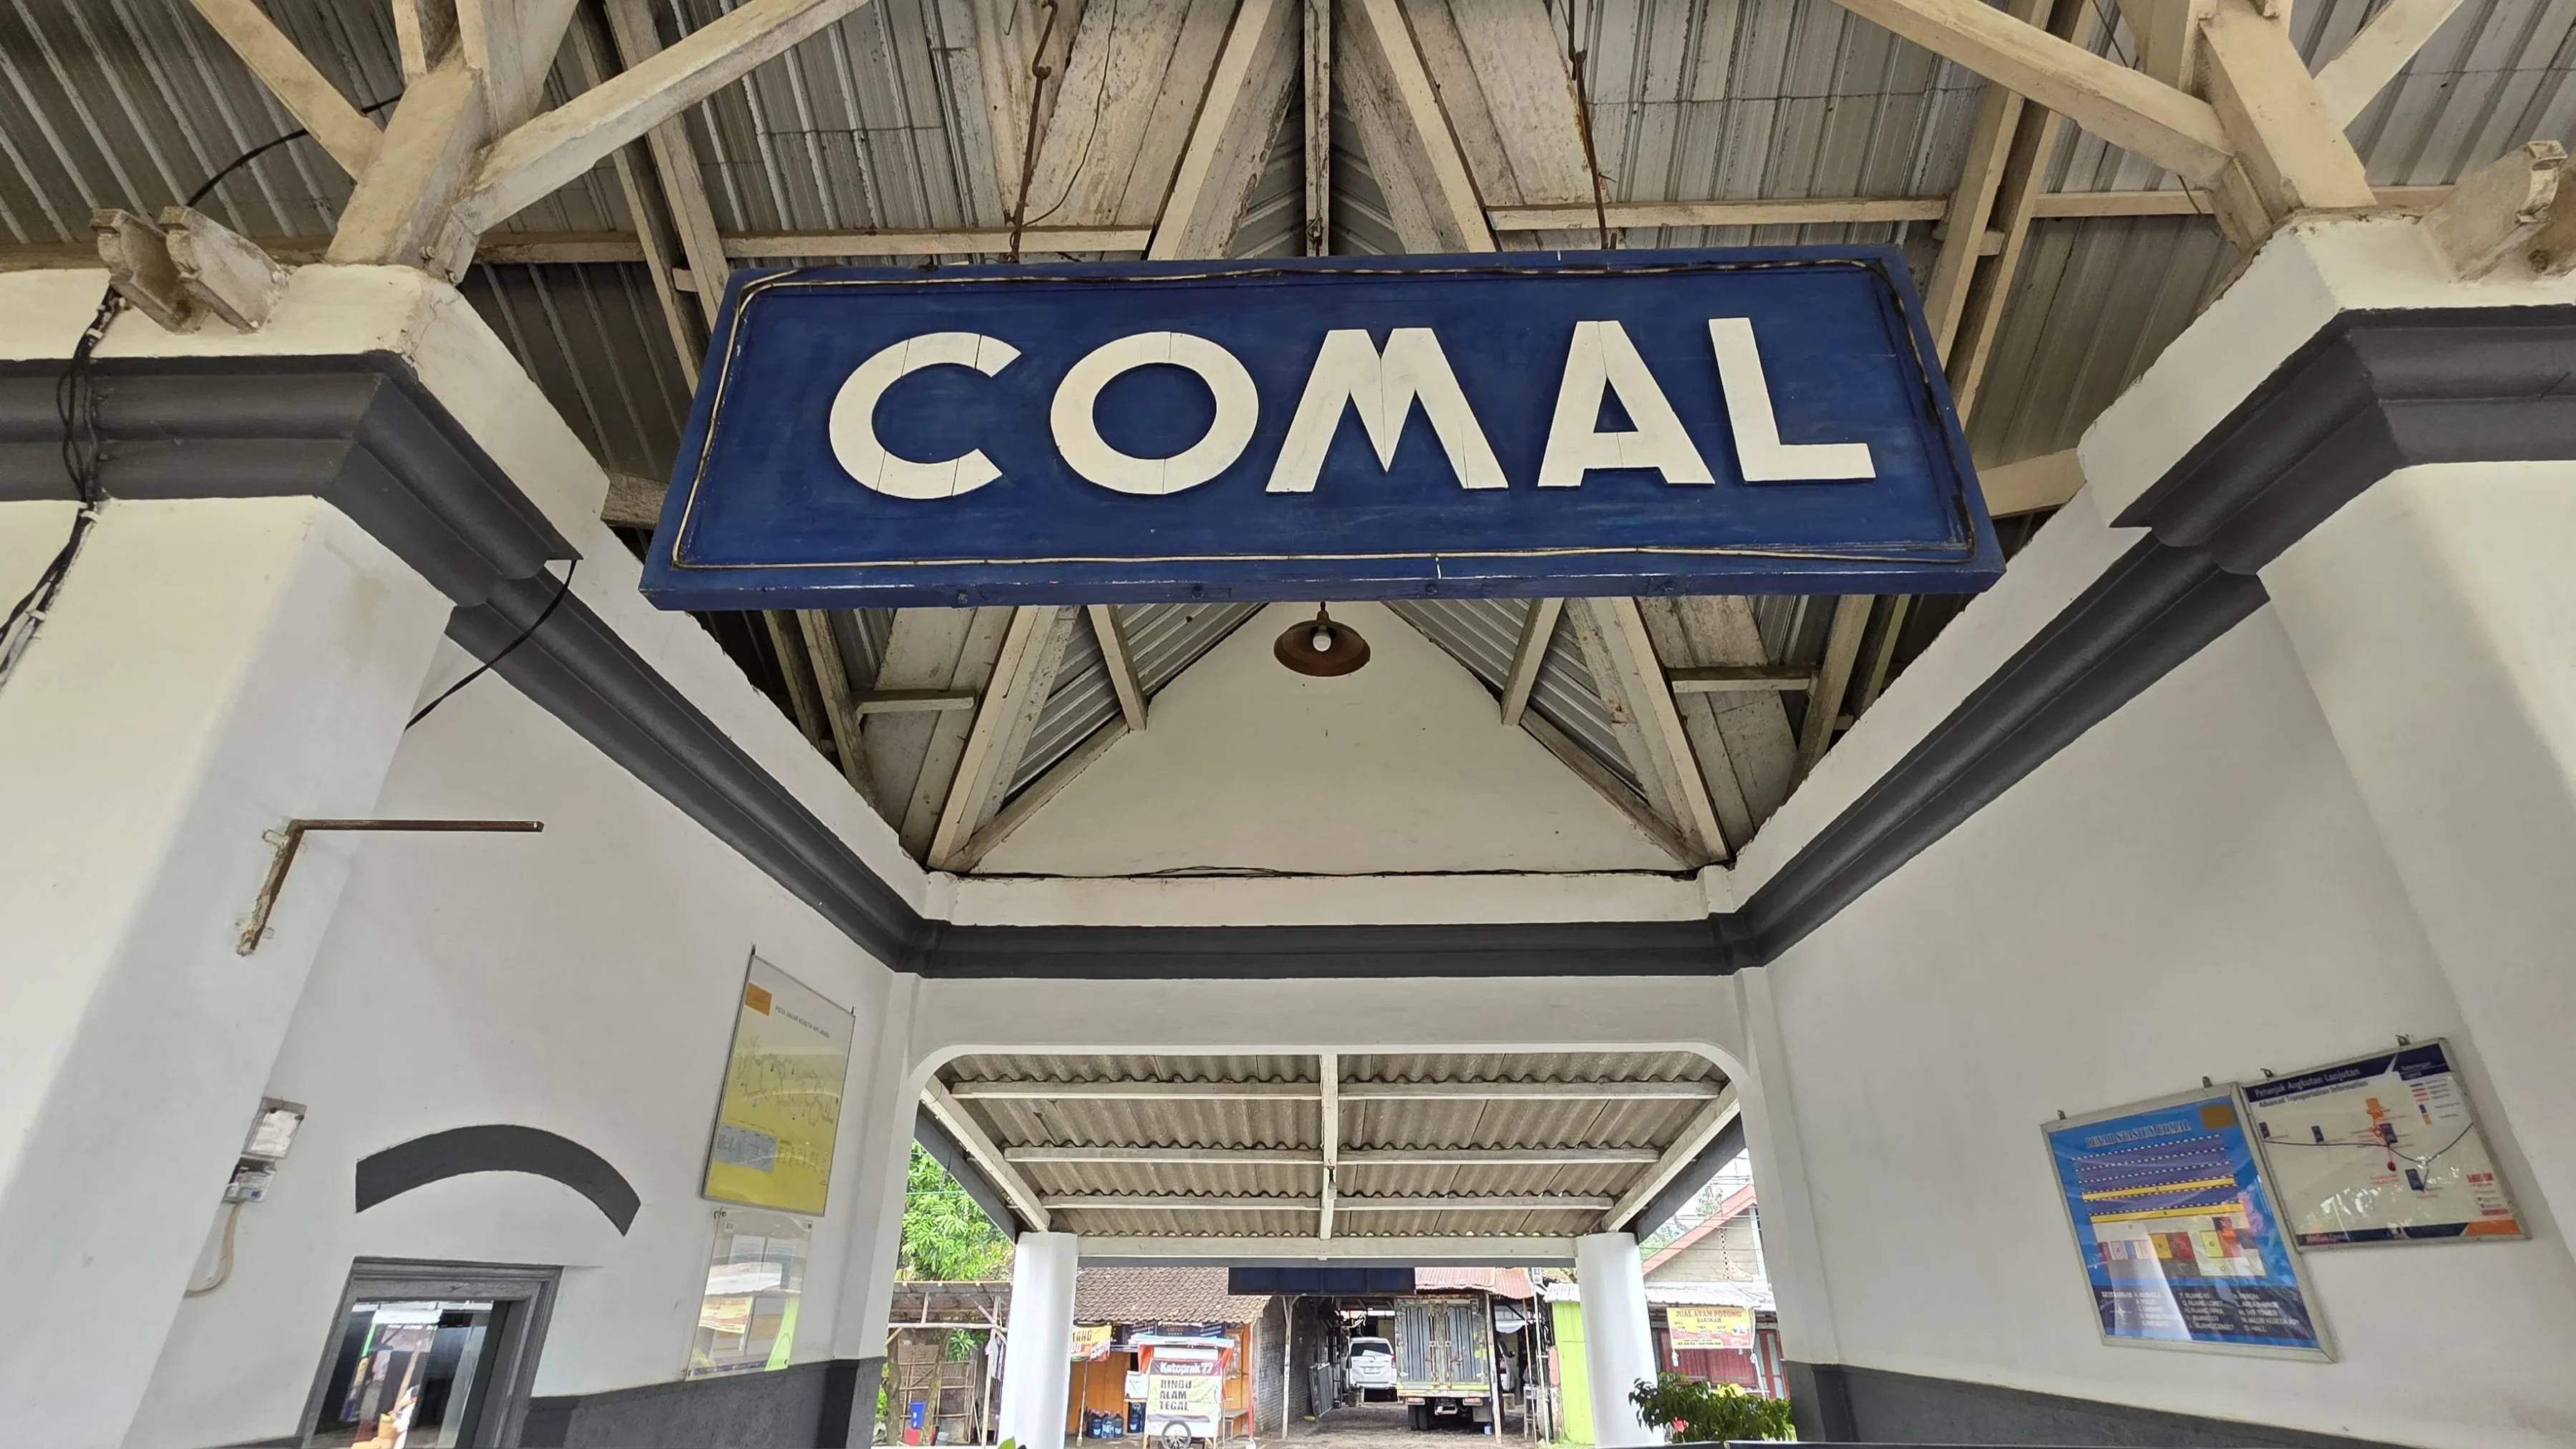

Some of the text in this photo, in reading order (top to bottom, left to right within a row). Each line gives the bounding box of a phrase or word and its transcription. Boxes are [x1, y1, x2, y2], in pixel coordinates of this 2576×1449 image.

[829, 316, 1877, 500] COMAL
[2287, 1075, 2323, 1090] Angkutan
[2323, 1067, 2361, 1082] Lanjutan
[1676, 1309, 1742, 1318] JUAL AYAM POTONG
[1160, 1361, 1201, 1375] Ketoprak
[1160, 1379, 1192, 1390] RINDU
[1160, 1390, 1187, 1400] ALAM
[1160, 1400, 1190, 1411] TEGAL
